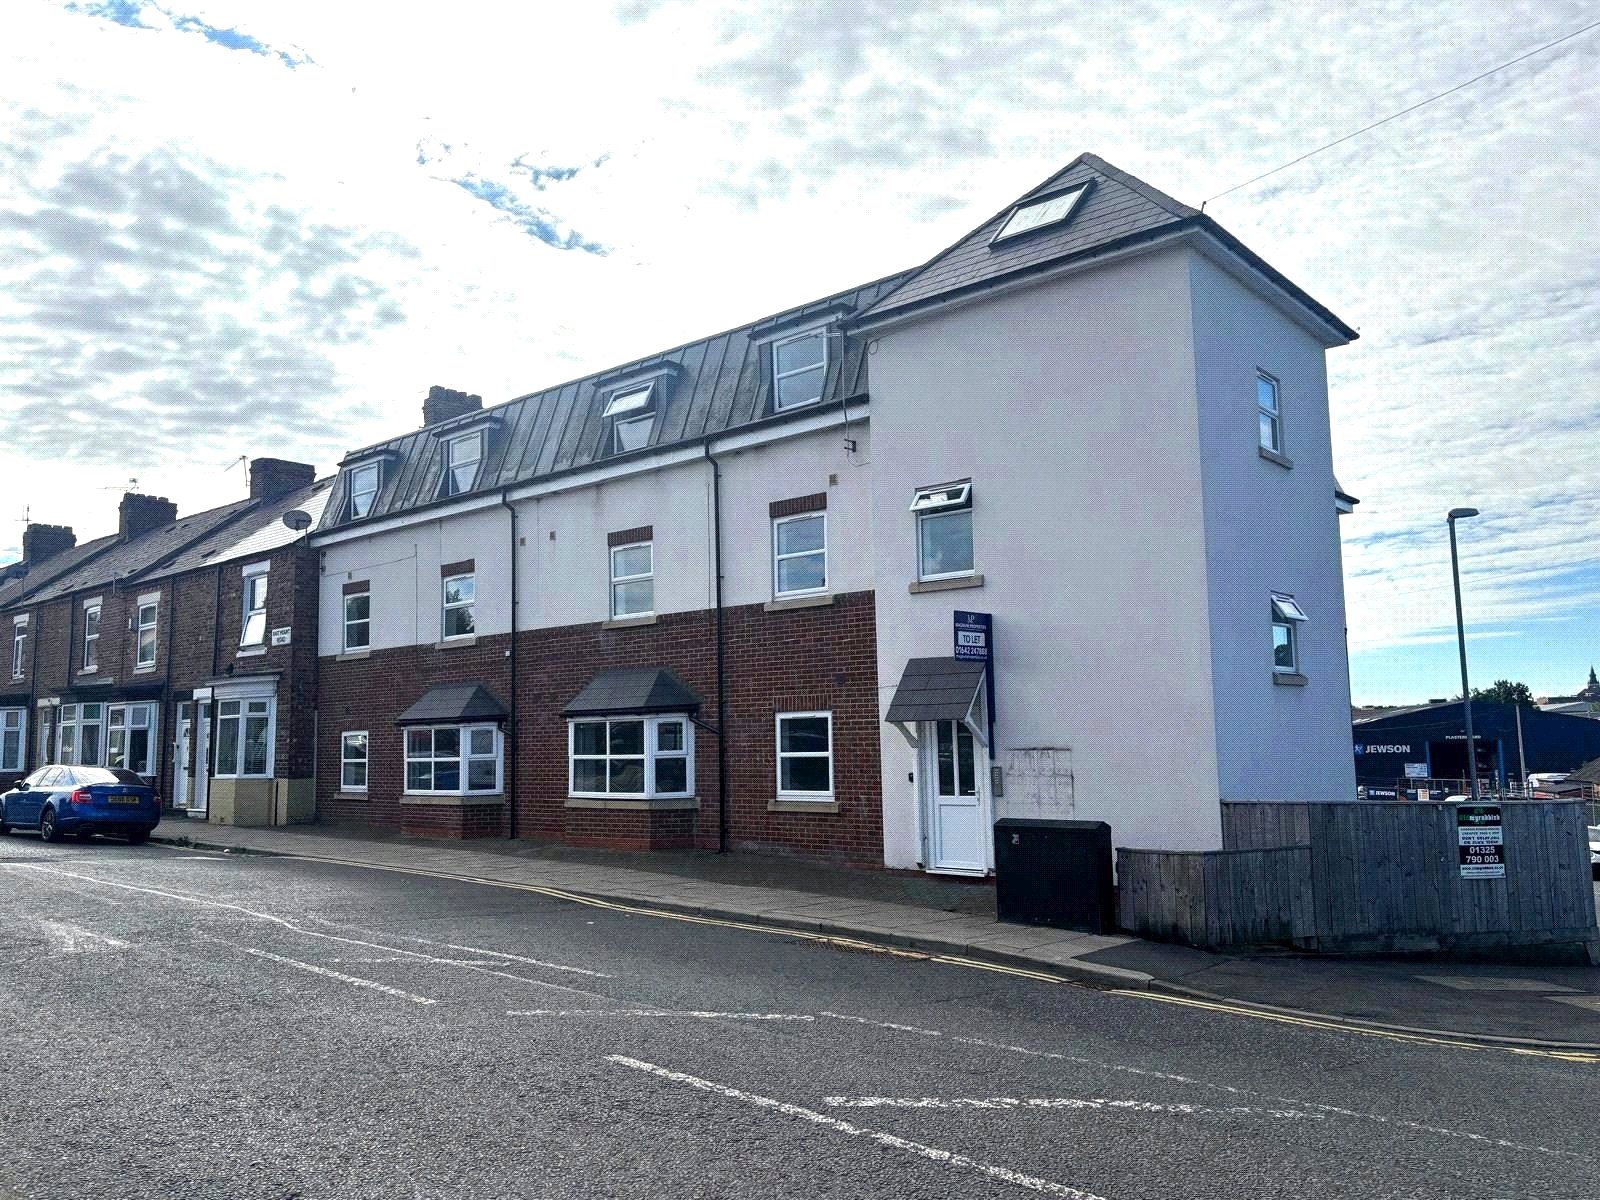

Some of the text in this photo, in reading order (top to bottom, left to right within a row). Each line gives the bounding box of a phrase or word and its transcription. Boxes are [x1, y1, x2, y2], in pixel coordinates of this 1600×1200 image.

[962, 635, 981, 643] TO LET
[955, 646, 970, 654] 01642
[1365, 744, 1411, 754] JEWSON
[1469, 846, 1496, 854] 01325
[1465, 855, 1499, 863] 790 003
